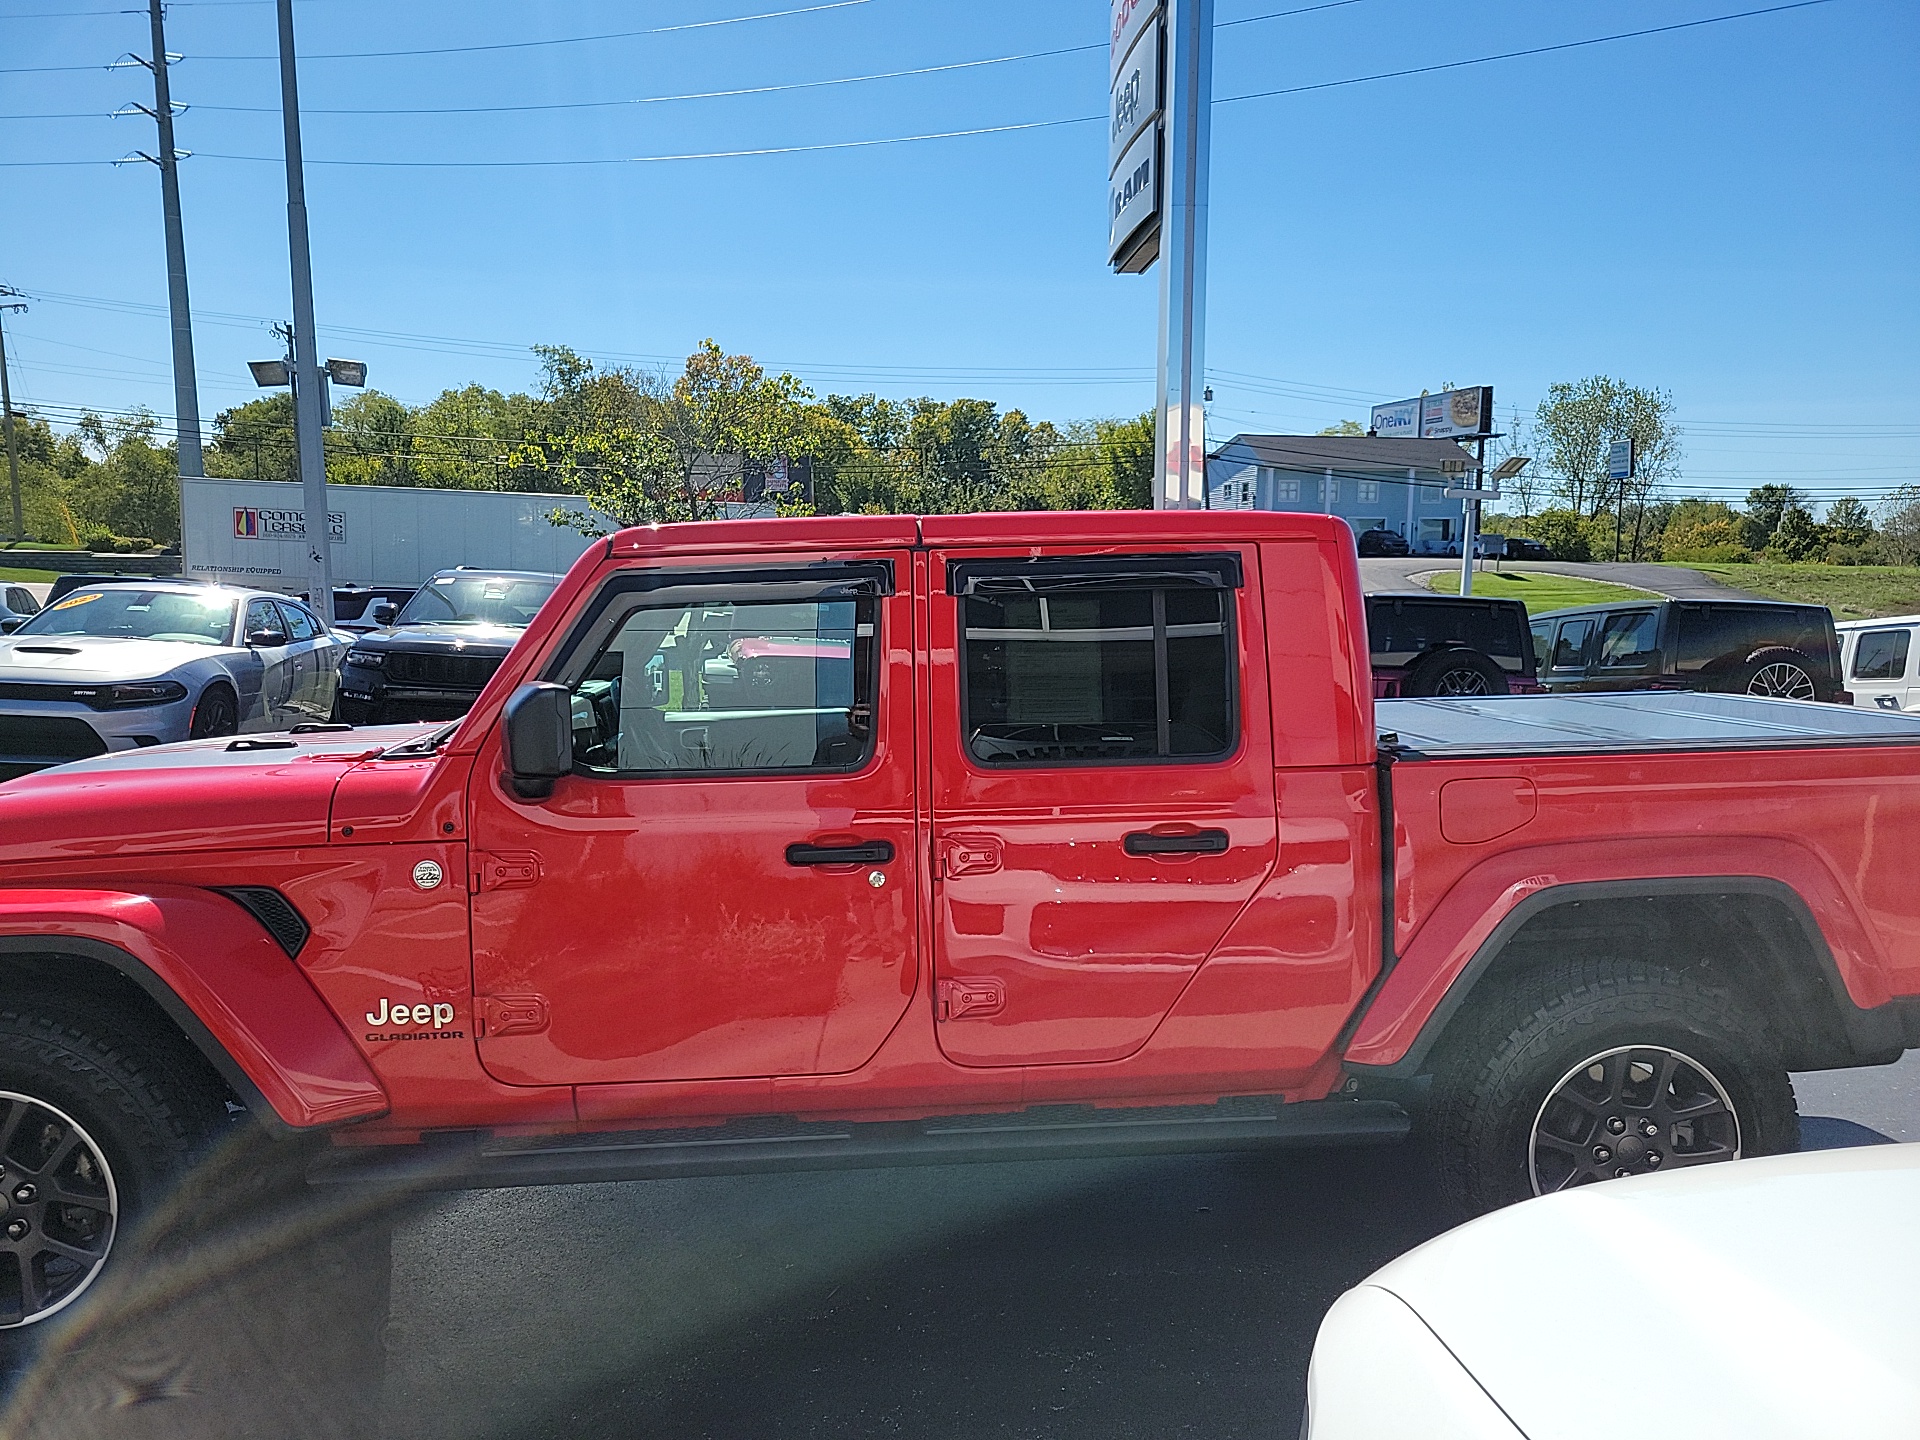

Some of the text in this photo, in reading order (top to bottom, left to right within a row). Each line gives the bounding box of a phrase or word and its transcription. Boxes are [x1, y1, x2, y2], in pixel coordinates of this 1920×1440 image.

[1115, 158, 1150, 221] RAM
[191, 564, 282, 575] RELATIONSHIP EQUIPPED
[365, 997, 455, 1030] Jeep
[364, 1030, 465, 1042] GLADIATOR
